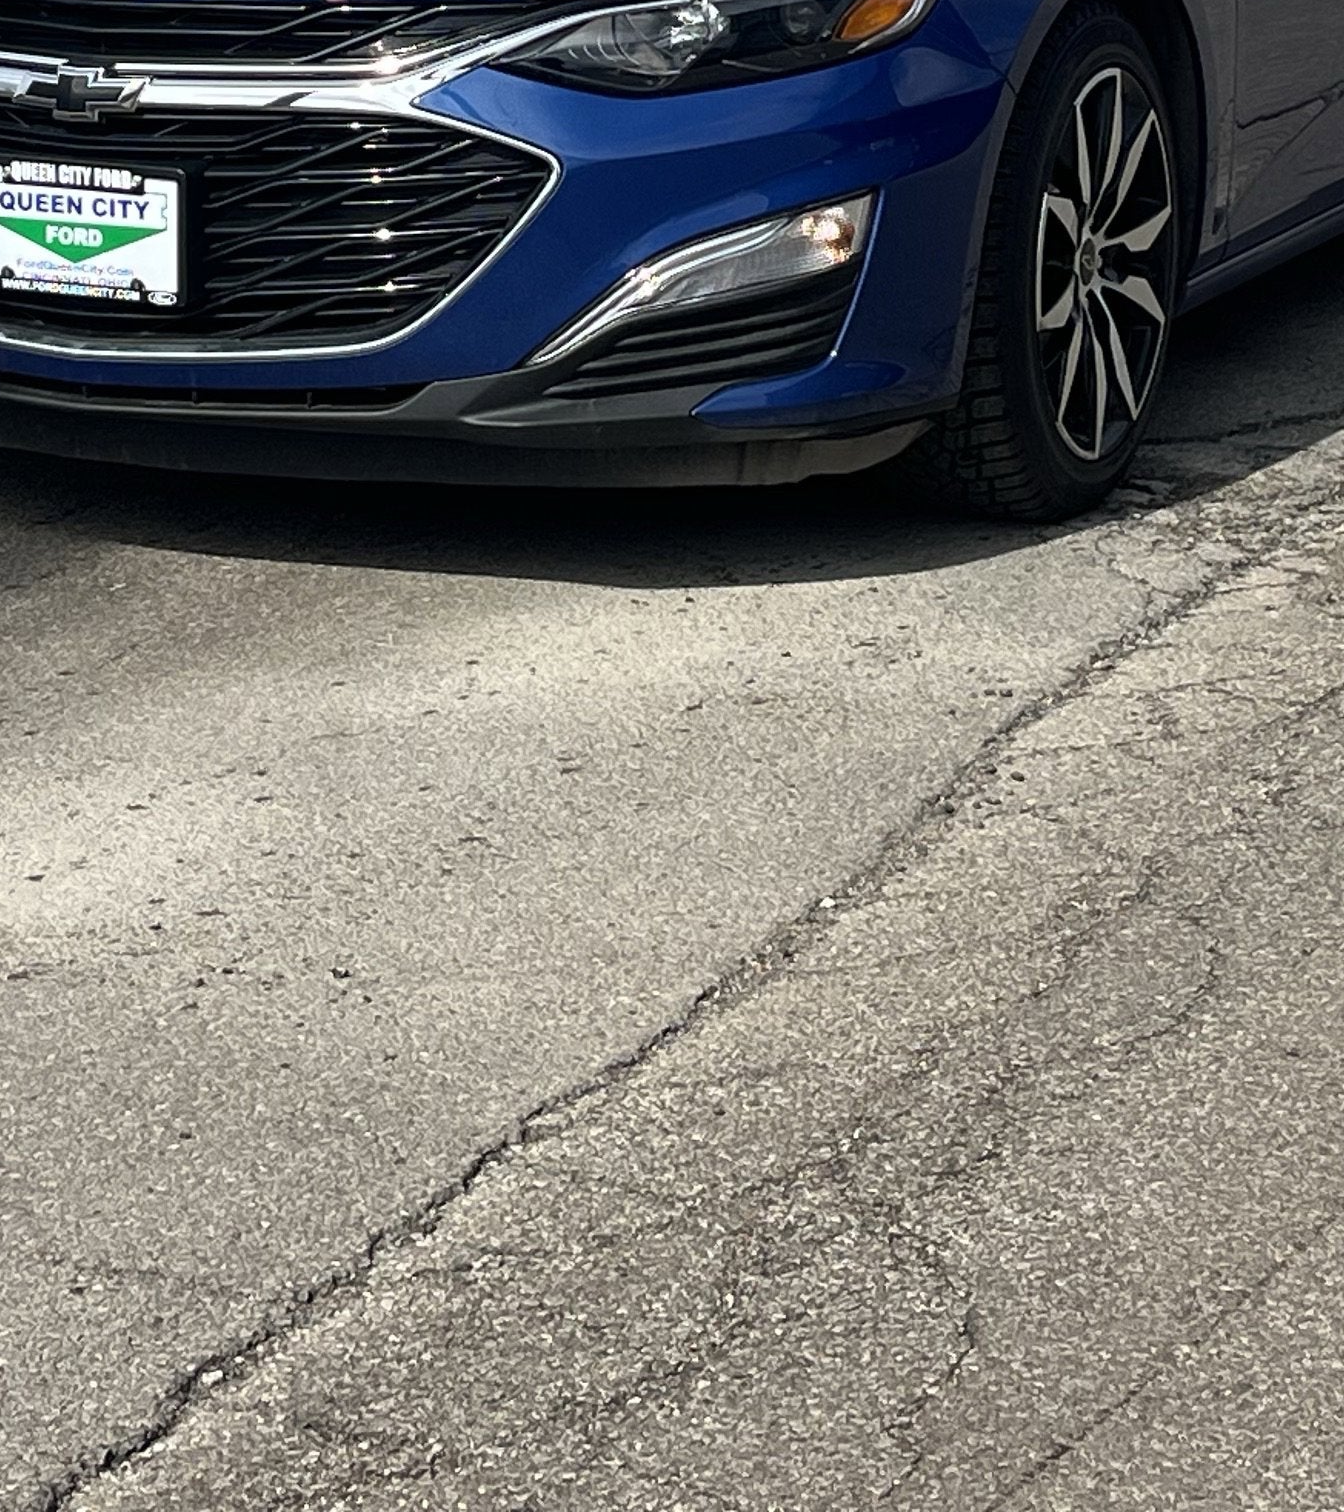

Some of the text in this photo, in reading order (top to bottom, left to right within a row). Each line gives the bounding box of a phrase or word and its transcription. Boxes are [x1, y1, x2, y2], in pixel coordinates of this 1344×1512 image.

[10, 160, 132, 190] QUEEN CITY FORD
[0, 191, 150, 220] QUEEN CITY
[45, 224, 104, 248] FORD
